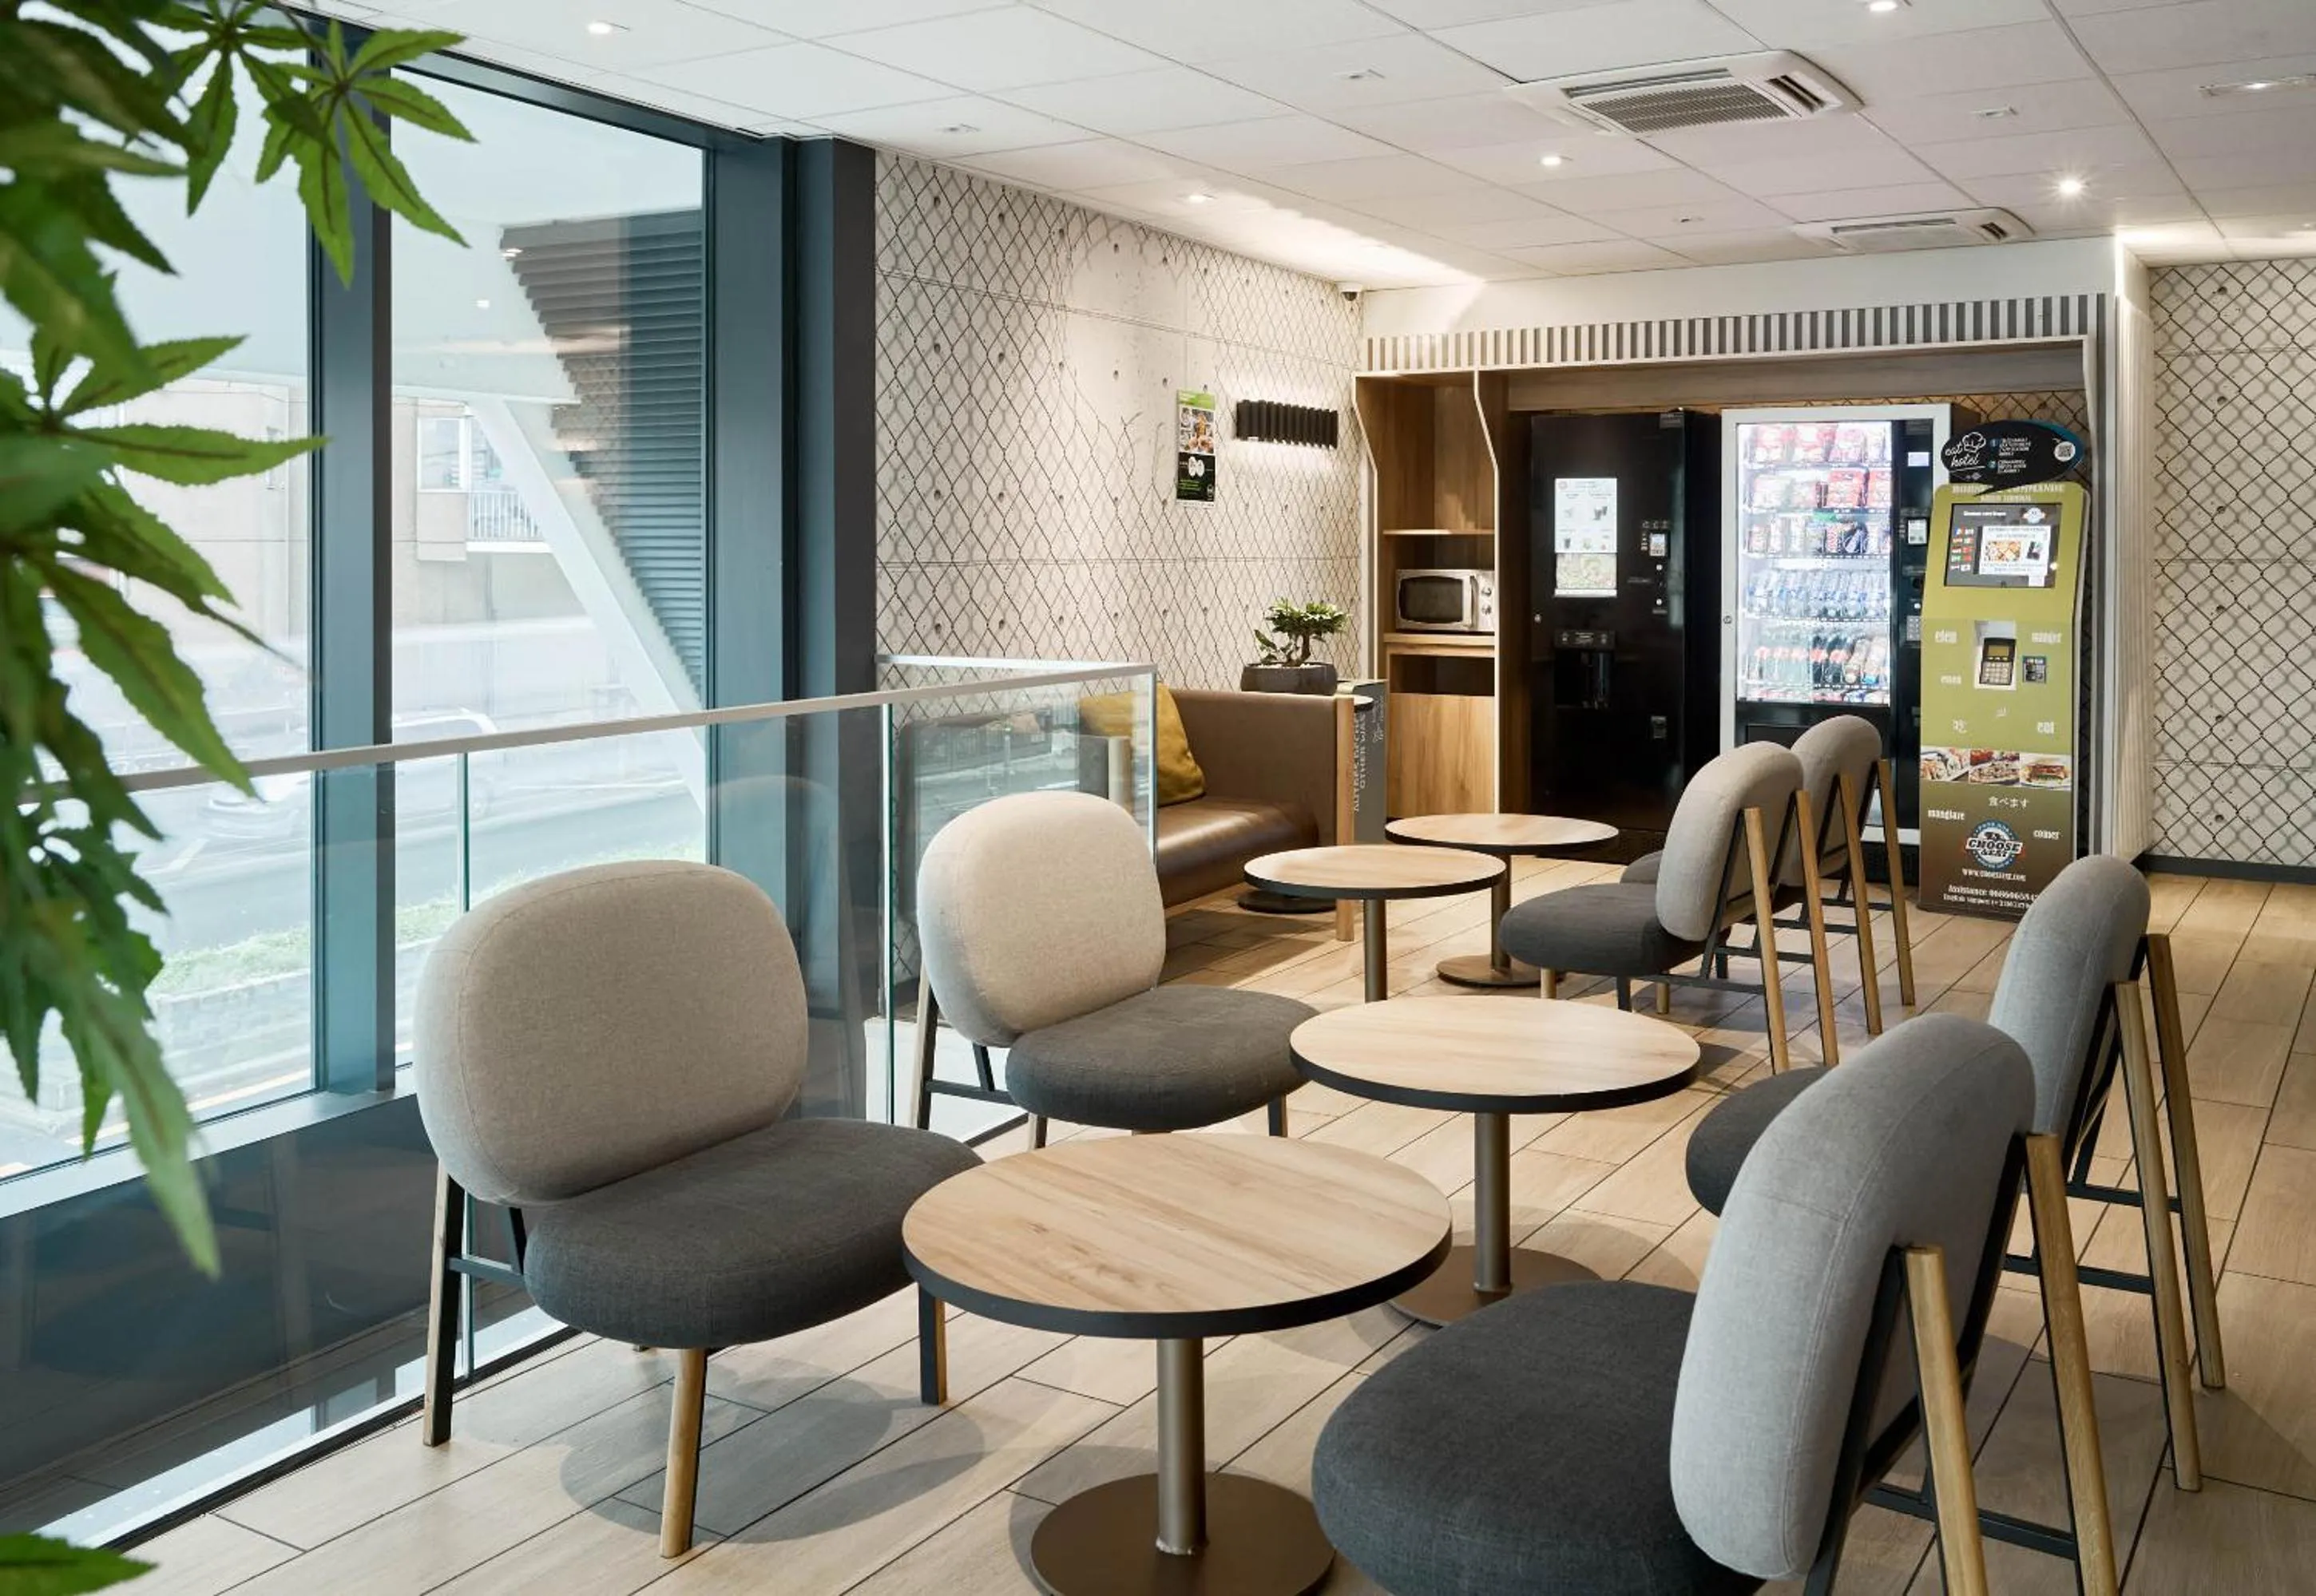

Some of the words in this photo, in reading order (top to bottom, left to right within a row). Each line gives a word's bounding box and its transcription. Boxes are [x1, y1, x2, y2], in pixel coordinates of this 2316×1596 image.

[1945, 442, 1963, 456] eat
[1951, 453, 1980, 467] hotel
[1989, 796, 2029, 809] 食べます
[1969, 839, 2021, 853] CHOOSE
